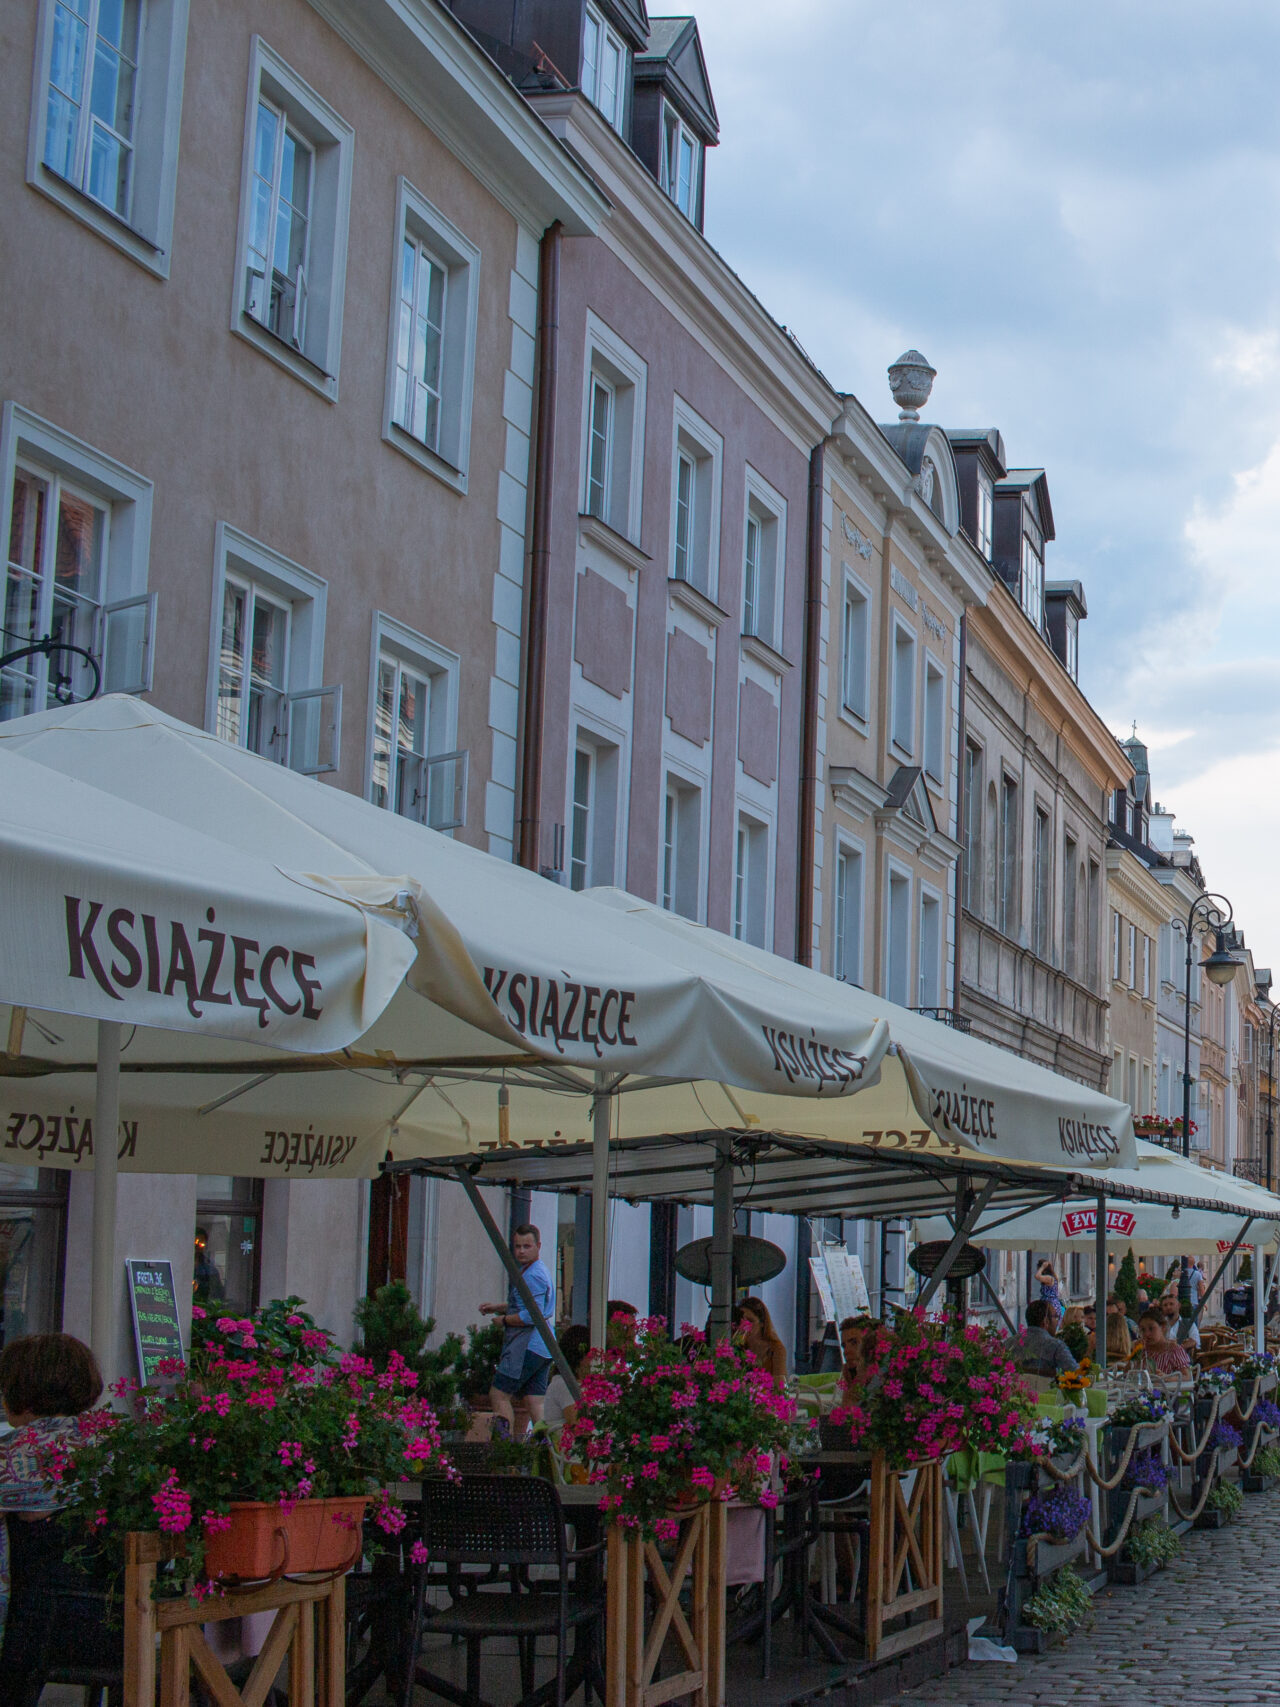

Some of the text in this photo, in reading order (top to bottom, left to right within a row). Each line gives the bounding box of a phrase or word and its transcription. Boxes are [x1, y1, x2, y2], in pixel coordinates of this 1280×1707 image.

[64, 895, 323, 1028] KSIĄŻĘCE
[931, 1083, 998, 1146] SIĄŻĘCE
[1058, 1112, 1121, 1161] KSIĄŻĘCE
